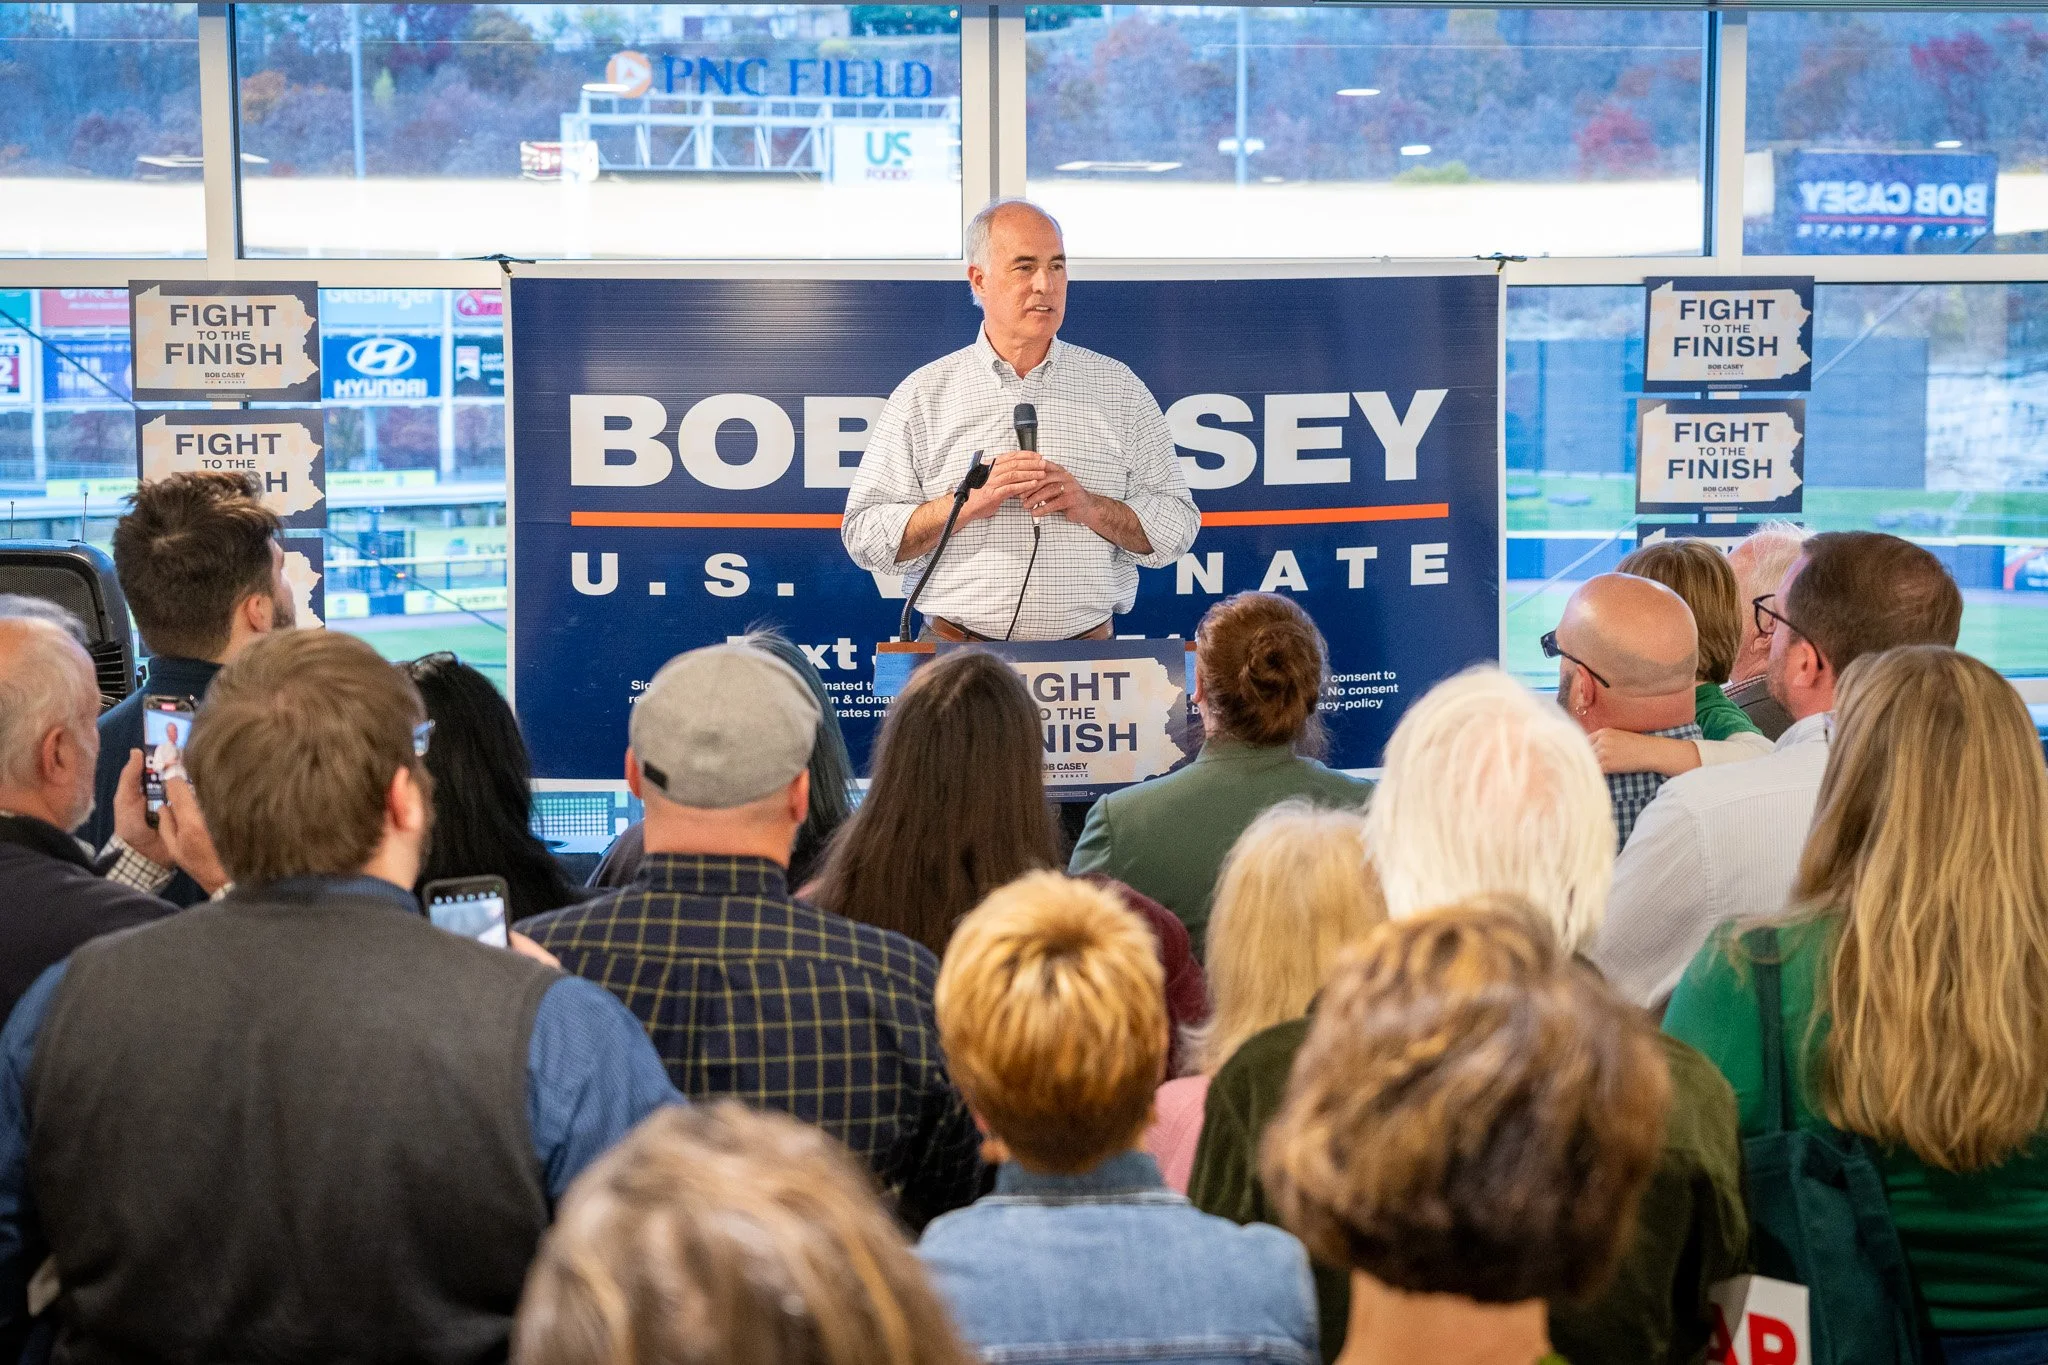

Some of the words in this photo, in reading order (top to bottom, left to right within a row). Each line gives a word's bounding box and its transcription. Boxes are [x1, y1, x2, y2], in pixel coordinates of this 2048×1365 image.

[664, 55, 768, 96] PNC
[788, 57, 932, 98] FIELD
[865, 130, 912, 167] US
[170, 304, 276, 326] FIGHT
[1680, 299, 1775, 321] FIGHT
[197, 331, 217, 340] TO
[221, 331, 250, 340] THE
[1703, 324, 1721, 333] TO
[1726, 324, 1750, 333] THE
[165, 343, 282, 365] FINISH
[1673, 336, 1778, 357] FINISH
[333, 378, 428, 399] HYUNDAI
[570, 393, 889, 490] BOB
[1165, 389, 1449, 490] SEY
[1674, 422, 1769, 443] FIGHT
[176, 433, 281, 455] FIGHT
[1698, 447, 1716, 456] TO
[1720, 447, 1745, 456] THE
[202, 459, 222, 469] TO
[226, 459, 256, 469] THE
[1668, 459, 1772, 479] FINISH
[1176, 543, 1448, 594] NATE
[631, 681, 652, 692] Sig
[823, 681, 863, 691] mated
[1331, 671, 1382, 683] consent
[1383, 671, 1397, 680] to
[1020, 671, 1130, 703] IGHT
[843, 694, 853, 704] &
[855, 694, 896, 704] donat
[1327, 686, 1346, 697] No
[1348, 683, 1399, 695] consent
[836, 708, 871, 718] rates
[1317, 699, 1384, 712] acy-policy
[1057, 707, 1096, 721] THE
[1043, 722, 1138, 753] NISH
[1057, 762, 1088, 771] CASEY
